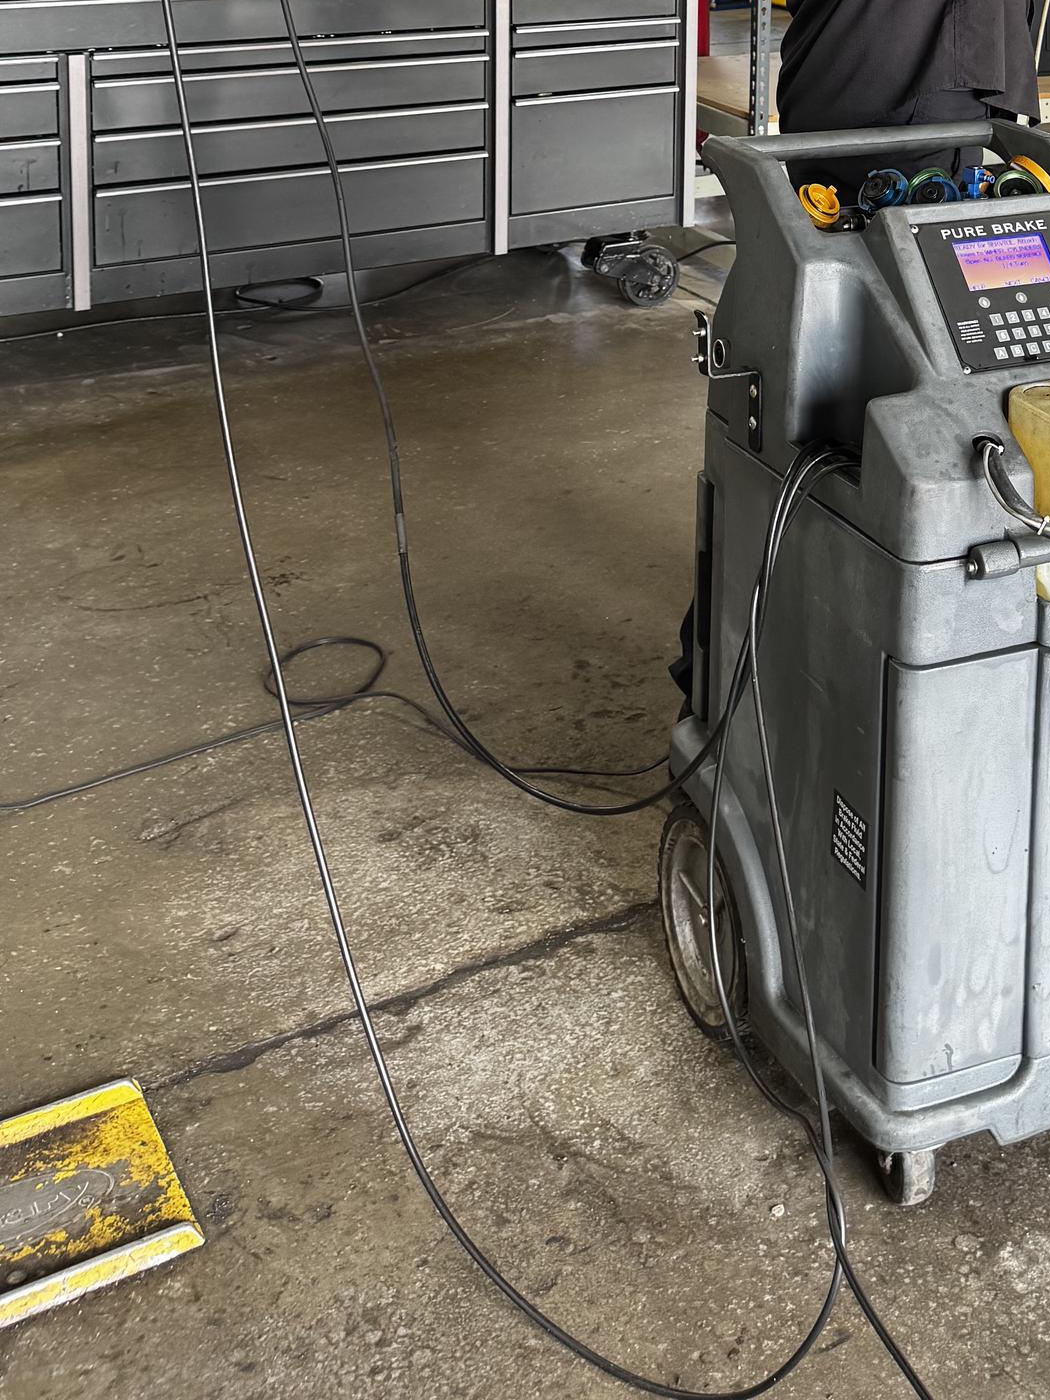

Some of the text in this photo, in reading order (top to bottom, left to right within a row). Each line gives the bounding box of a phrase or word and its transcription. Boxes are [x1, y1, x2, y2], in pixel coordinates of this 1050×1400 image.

[940, 219, 1047, 240] PURE BRAKE
[837, 795, 853, 819] Dispose
[838, 808, 851, 827] Brake
[840, 821, 865, 852] Accordance
